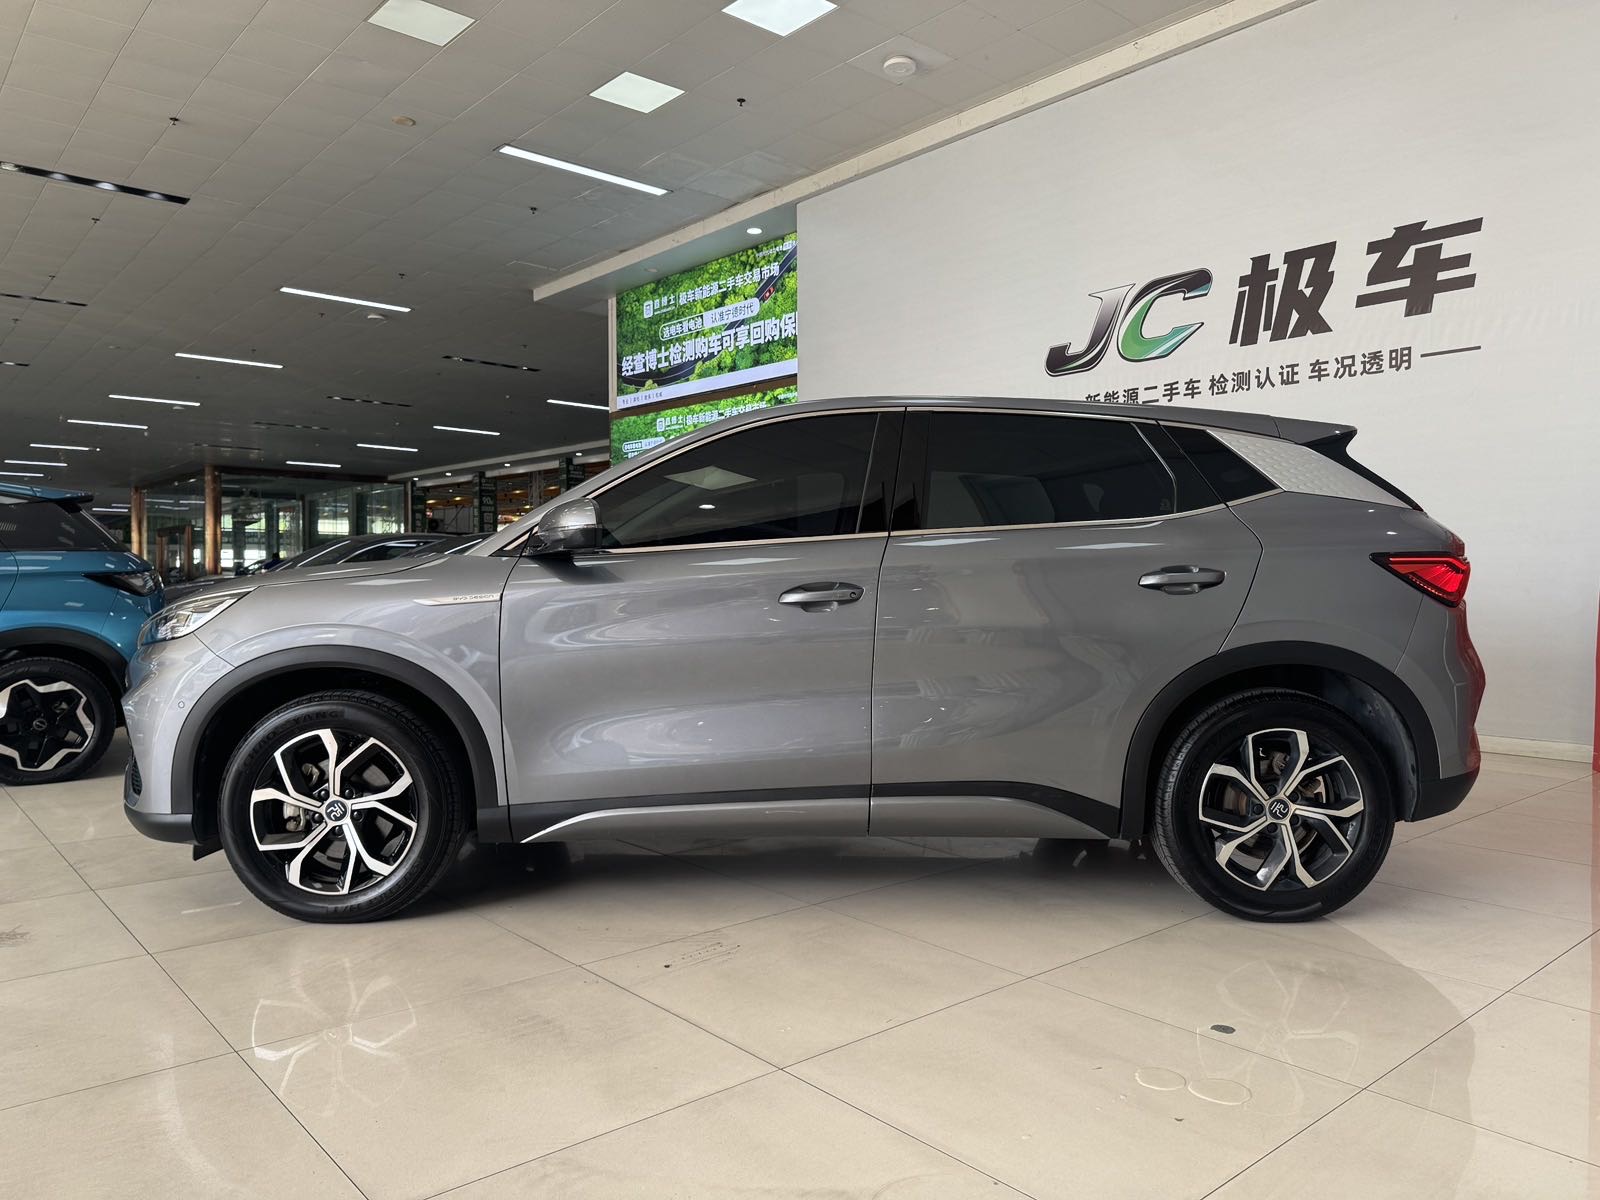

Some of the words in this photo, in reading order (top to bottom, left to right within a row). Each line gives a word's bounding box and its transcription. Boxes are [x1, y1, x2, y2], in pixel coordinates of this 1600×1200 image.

[679, 262, 780, 306] 极车新能源二手车交易市场
[1229, 216, 1484, 347] 极车
[710, 301, 754, 324] 认准宁德时代
[1045, 267, 1213, 377] JC
[621, 311, 798, 377] 经查博士检测购车可享回购保
[1208, 363, 1301, 396] 检测认证
[1307, 345, 1413, 382] 车况透明
